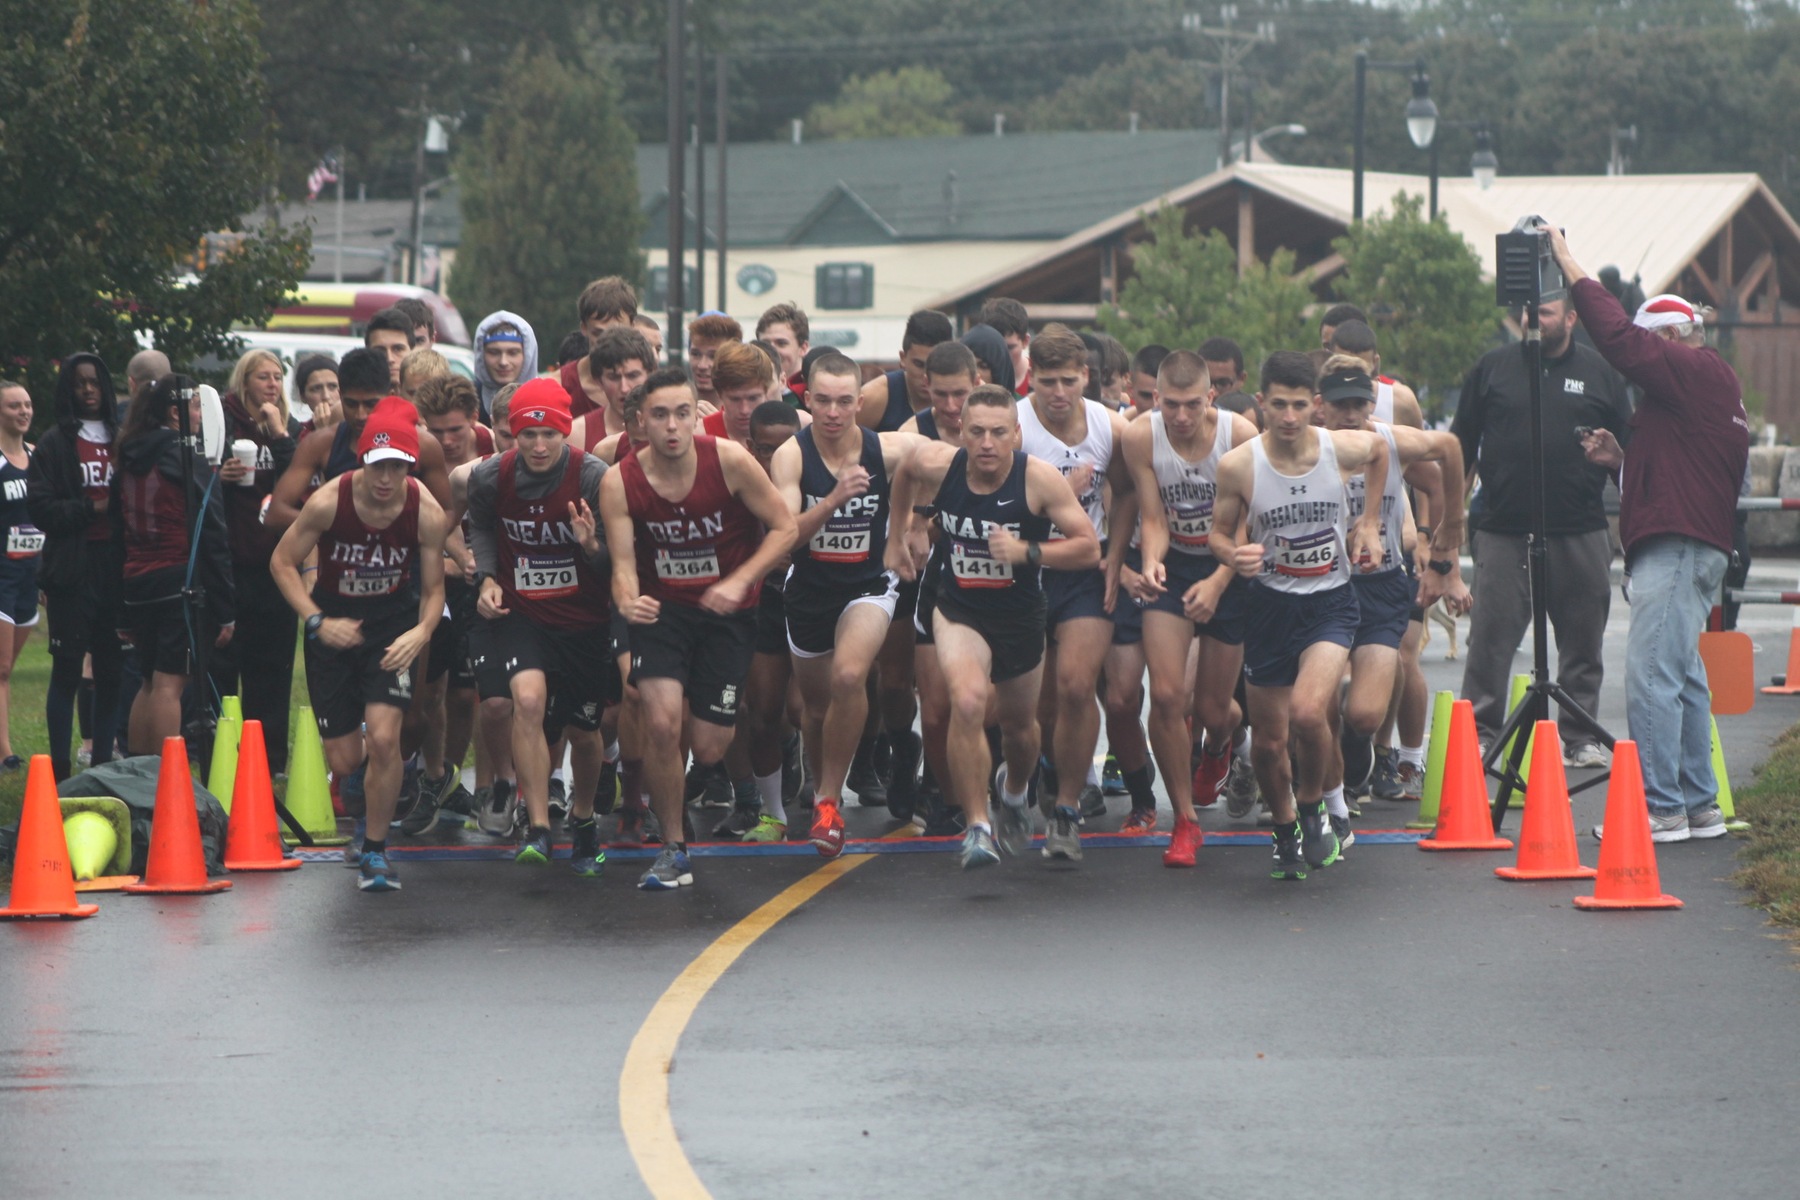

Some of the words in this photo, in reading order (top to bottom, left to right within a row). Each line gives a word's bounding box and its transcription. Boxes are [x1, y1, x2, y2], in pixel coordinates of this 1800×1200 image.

[806, 494, 879, 517] NPS
[646, 511, 723, 543] DEAN
[12, 538, 43, 550] 1427
[815, 535, 866, 550] 1407
[330, 541, 409, 568] DEAN
[1281, 547, 1332, 565] 1446
[662, 560, 713, 576] 1364
[956, 560, 1005, 577] 1411
[521, 571, 572, 587] 1370
